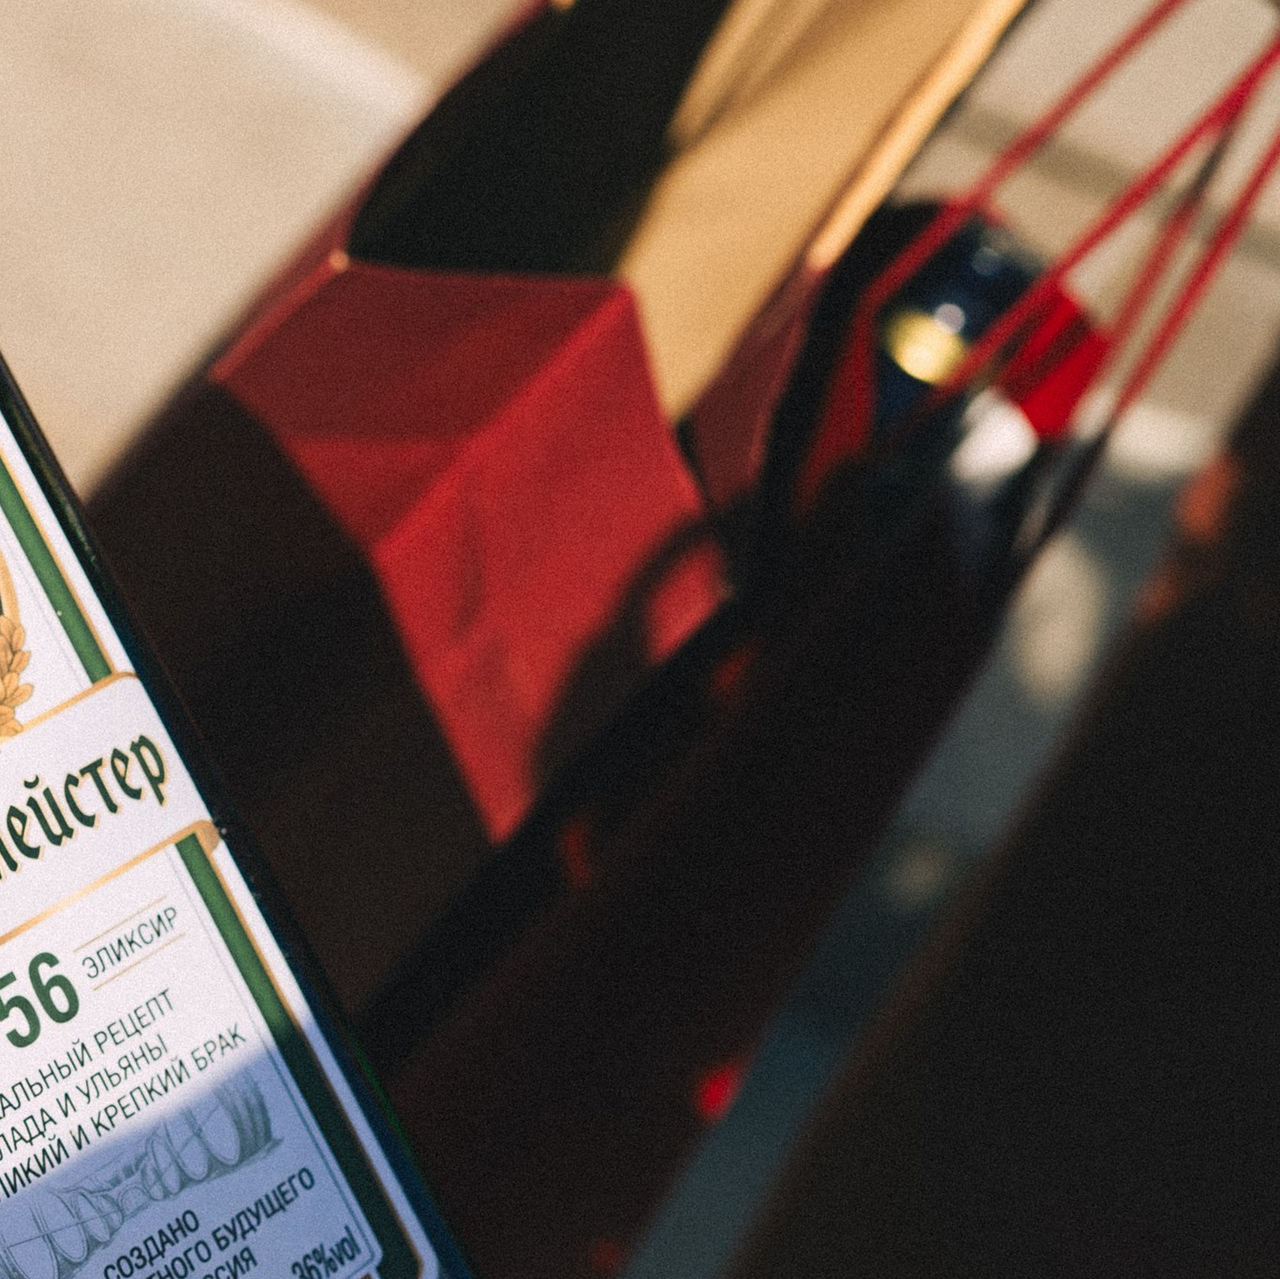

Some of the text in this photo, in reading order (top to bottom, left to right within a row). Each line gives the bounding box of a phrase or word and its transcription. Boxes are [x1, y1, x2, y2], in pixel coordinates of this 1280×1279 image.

[82, 906, 178, 979] ЭЛИКСИР
[93, 988, 174, 1054] РЕЦЕПТ
[56, 1092, 77, 1119] И
[76, 1034, 169, 1104] УЛЬЯНЫ
[70, 1124, 91, 1151] И
[91, 1056, 191, 1137] КРЕПКИЙ
[191, 1023, 247, 1072] БРАК
[212, 1167, 315, 1251] БУДУЩЕГО
